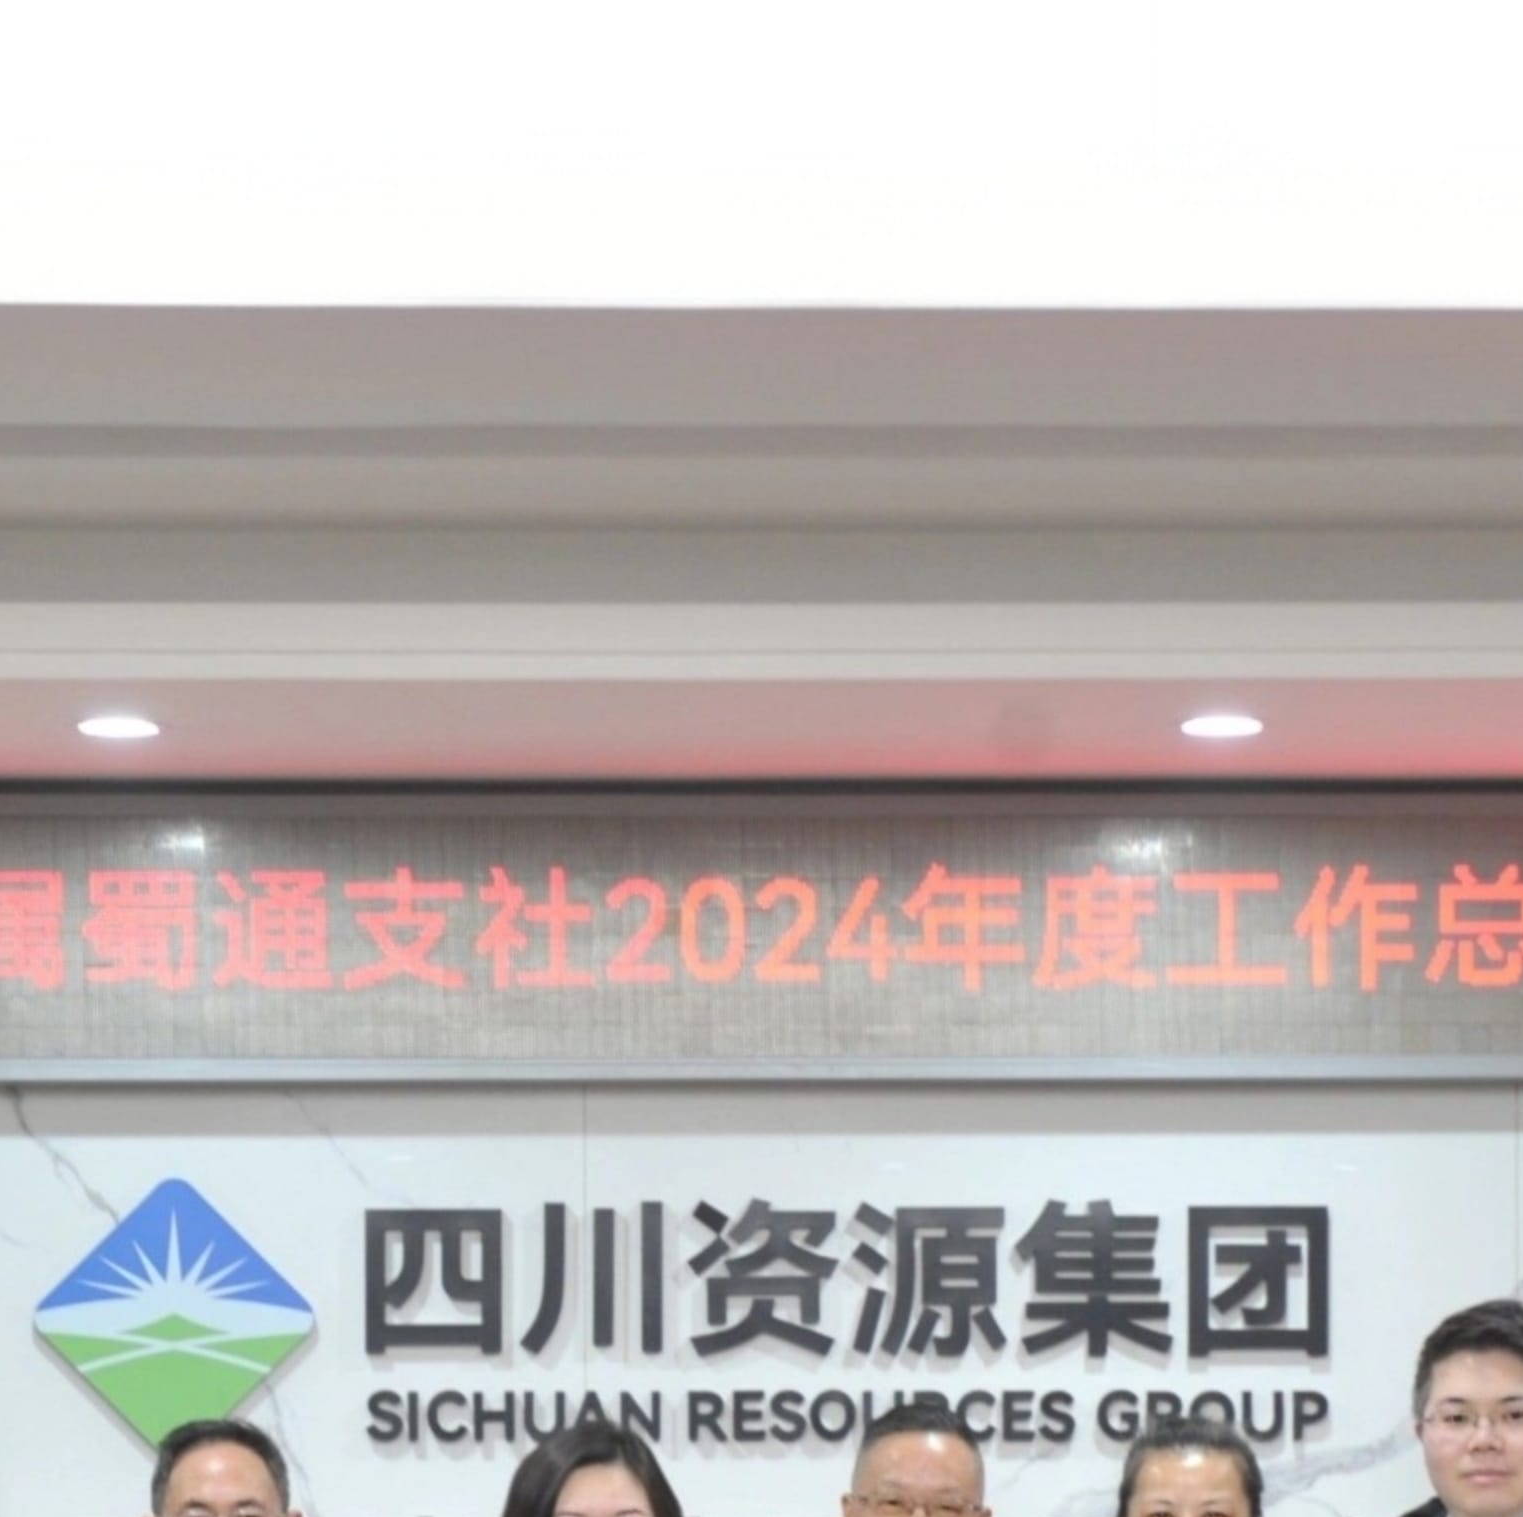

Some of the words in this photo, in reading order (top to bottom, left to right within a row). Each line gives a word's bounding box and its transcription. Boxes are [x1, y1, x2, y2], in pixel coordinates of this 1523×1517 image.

[364, 1202, 1329, 1358] 四川资源集团
[364, 1389, 662, 1443] SICHUAN
